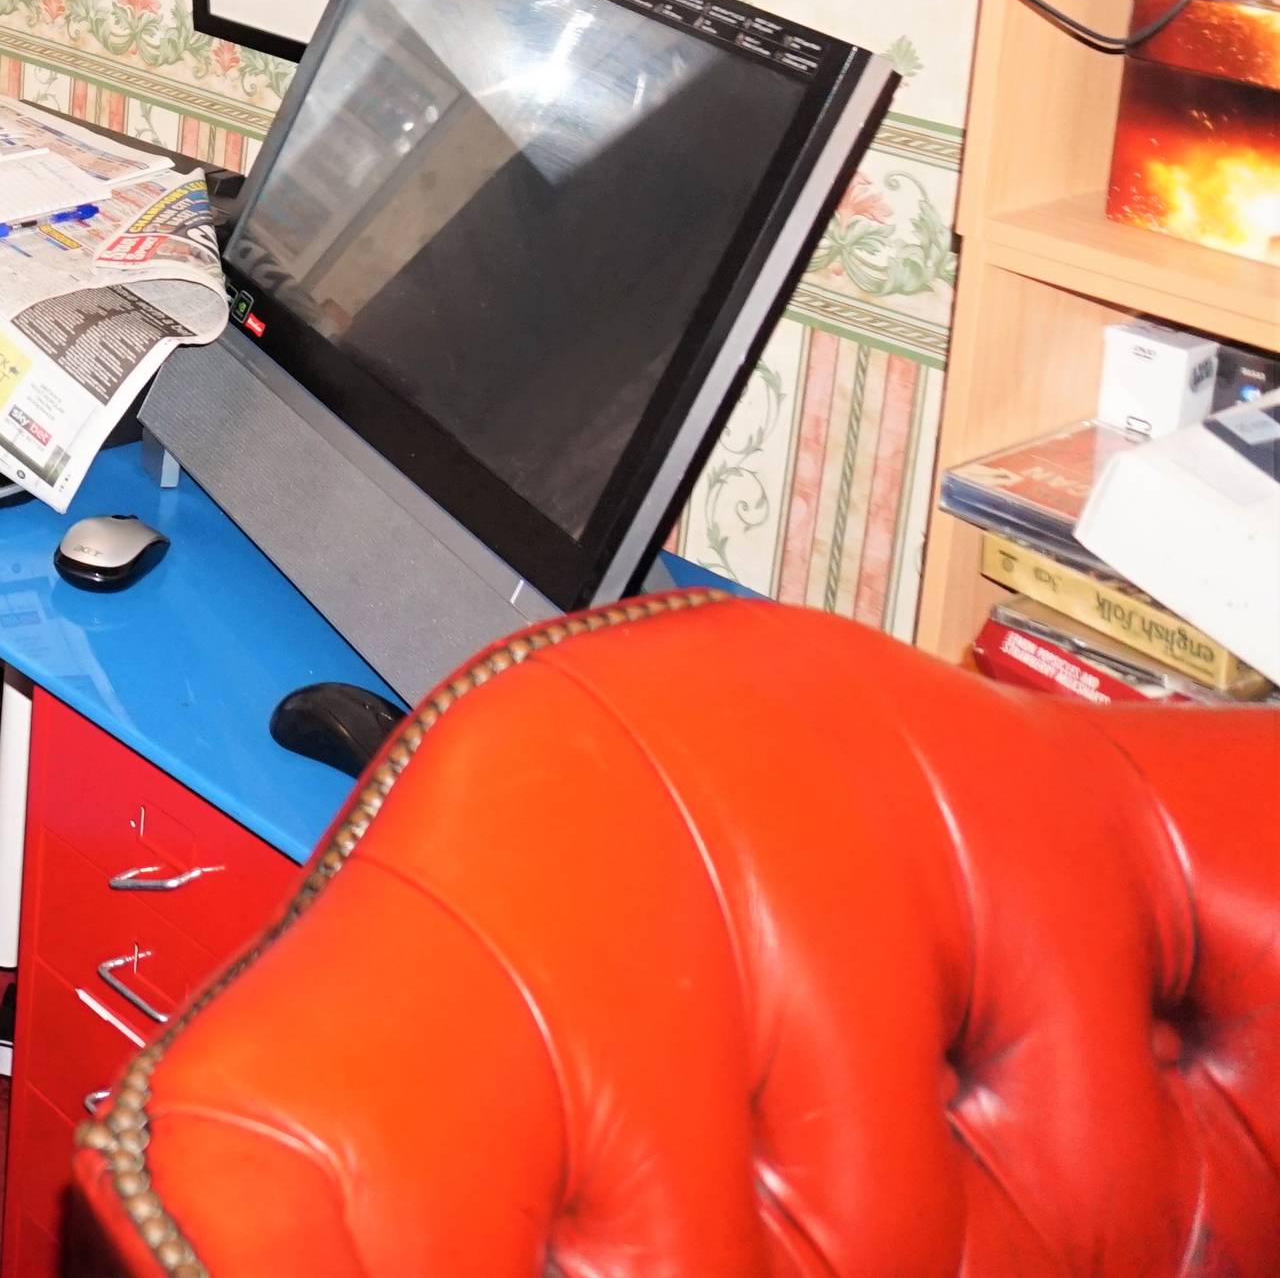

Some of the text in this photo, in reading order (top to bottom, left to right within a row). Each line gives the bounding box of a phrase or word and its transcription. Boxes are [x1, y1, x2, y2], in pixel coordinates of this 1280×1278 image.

[10, 406, 52, 444] sky bet
[1094, 589, 1216, 663] english folk
